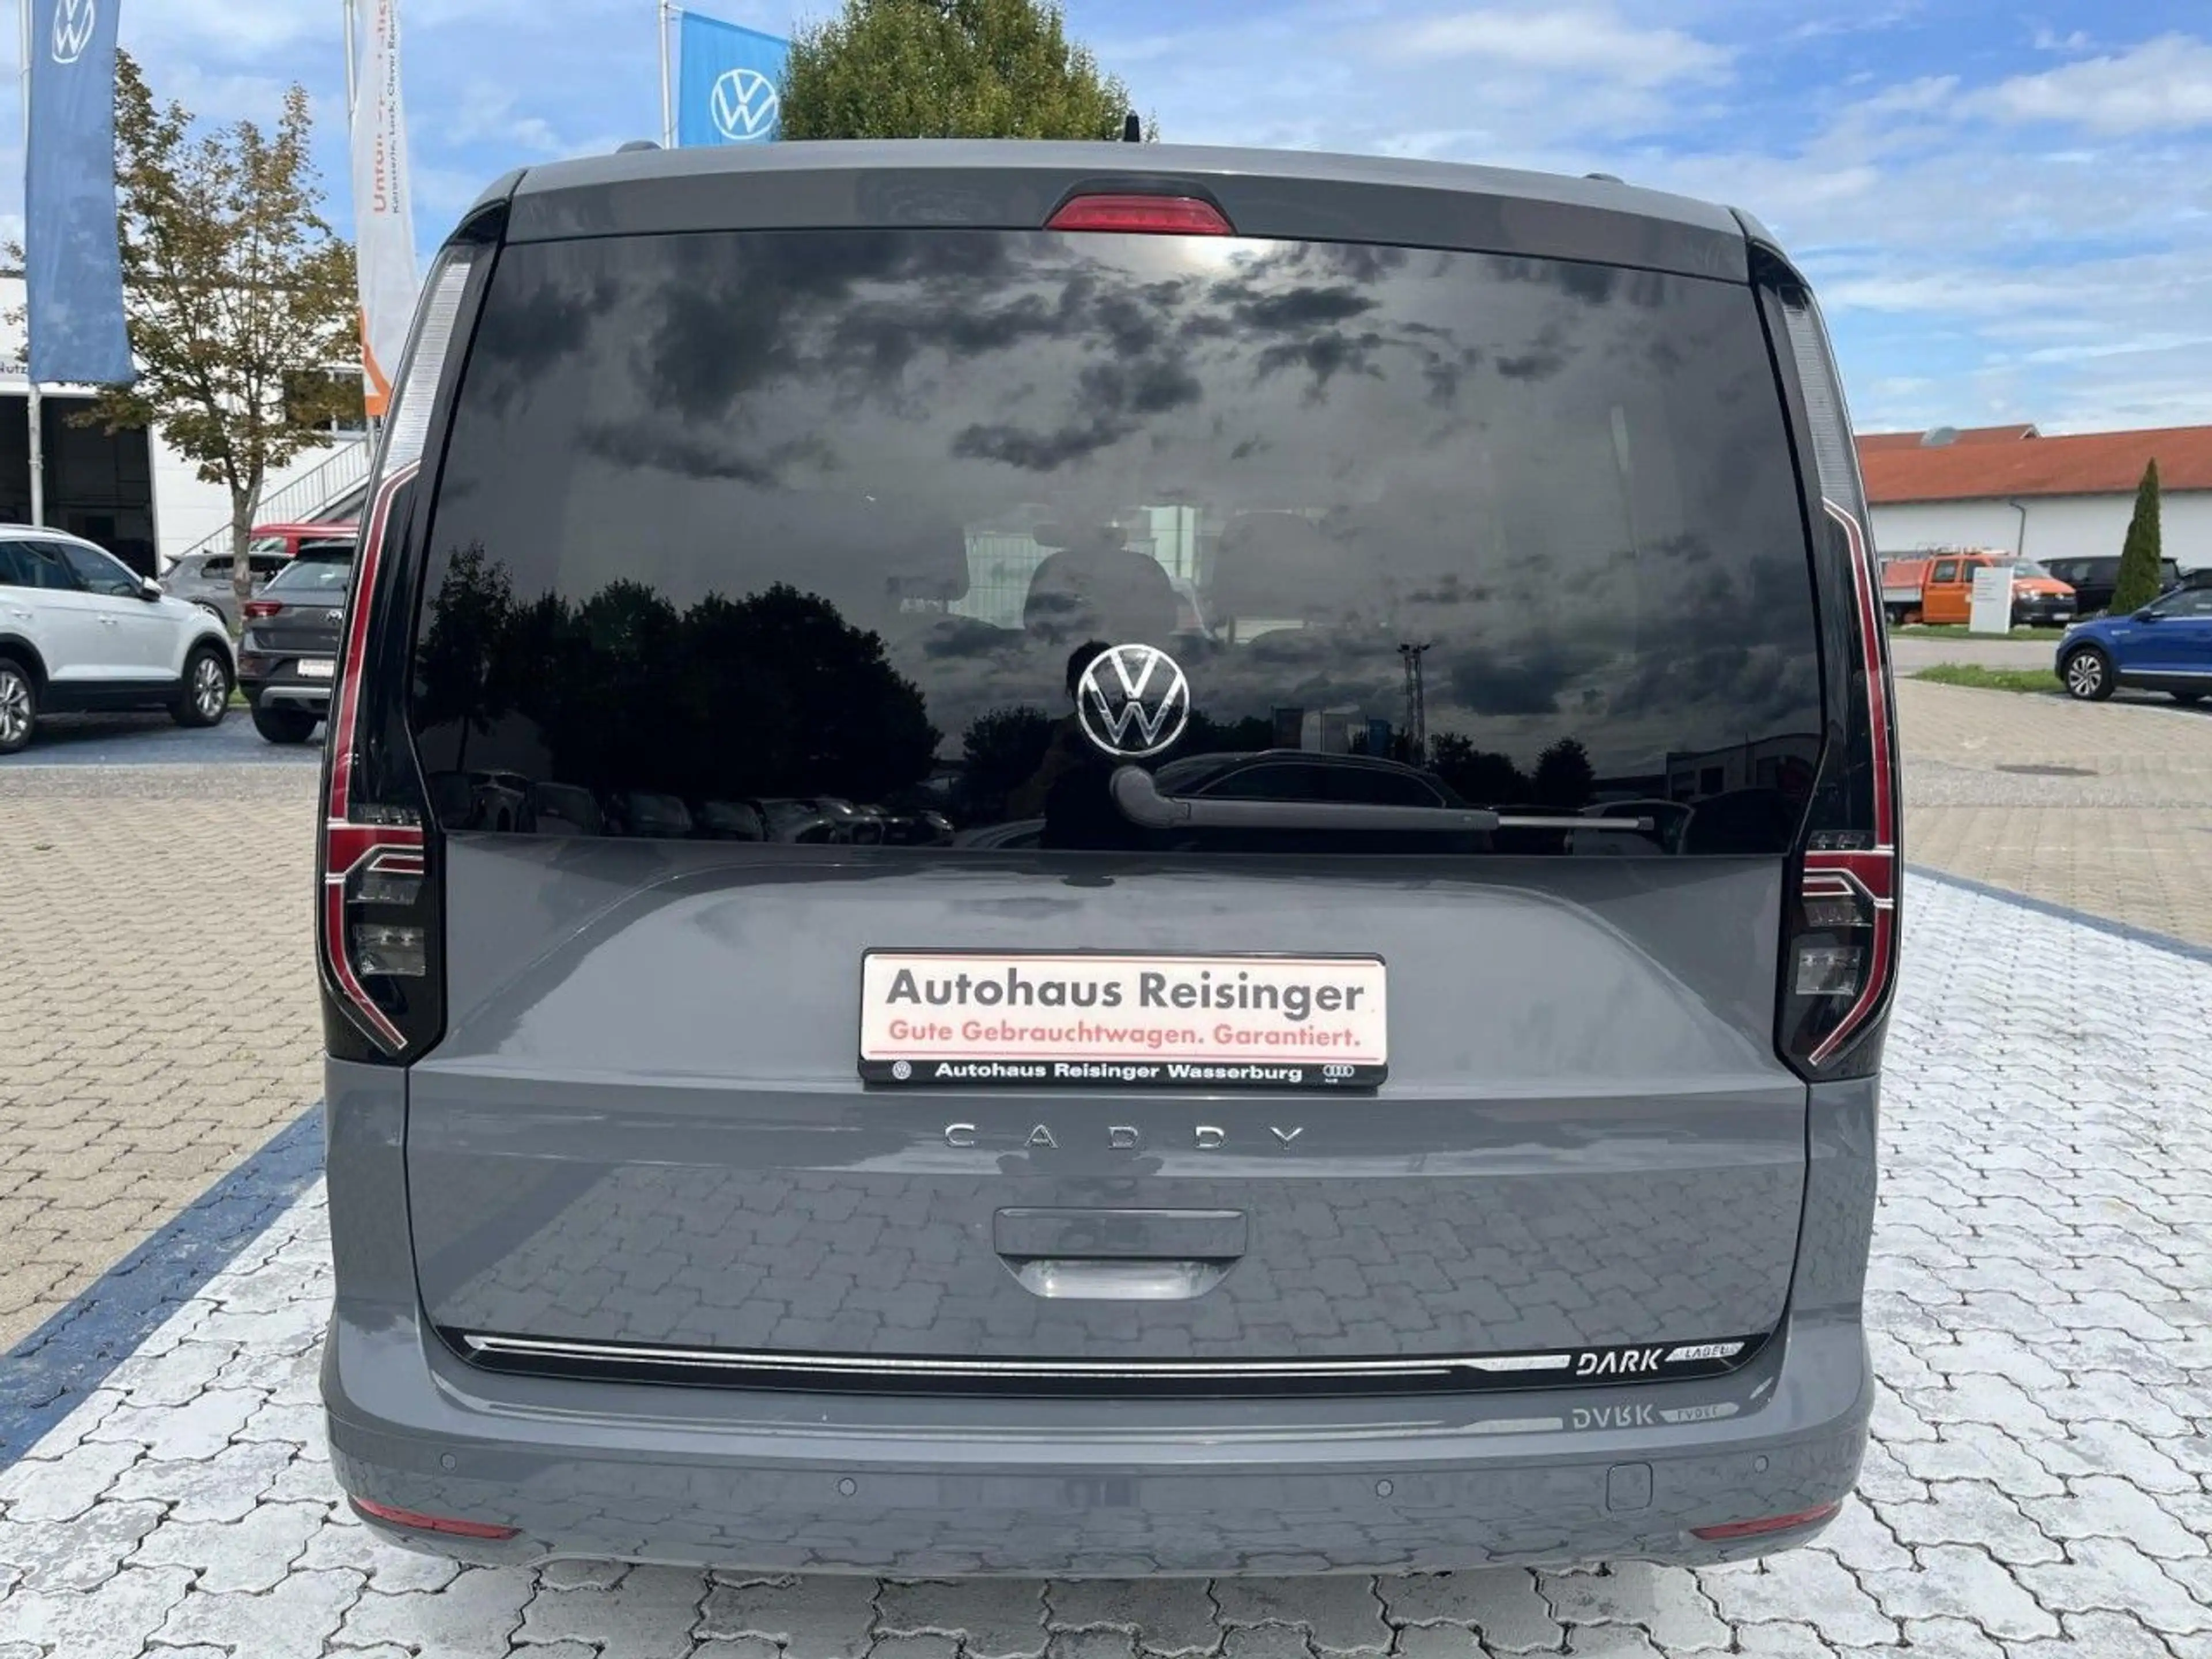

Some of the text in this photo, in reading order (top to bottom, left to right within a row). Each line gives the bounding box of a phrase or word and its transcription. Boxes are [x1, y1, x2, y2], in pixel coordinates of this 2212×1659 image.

[713, 70, 777, 136] VW
[1083, 646, 1185, 748] VW
[885, 967, 1365, 1021] Autohaus Reisinger
[889, 1019, 1362, 1049] Gute Gebrauchtwagen. Garantiert.
[935, 1062, 1303, 1083] Autohaus Reisinger Wasserburg
[945, 1122, 1304, 1149] CADDY
[1575, 1348, 1664, 1376] DARK
